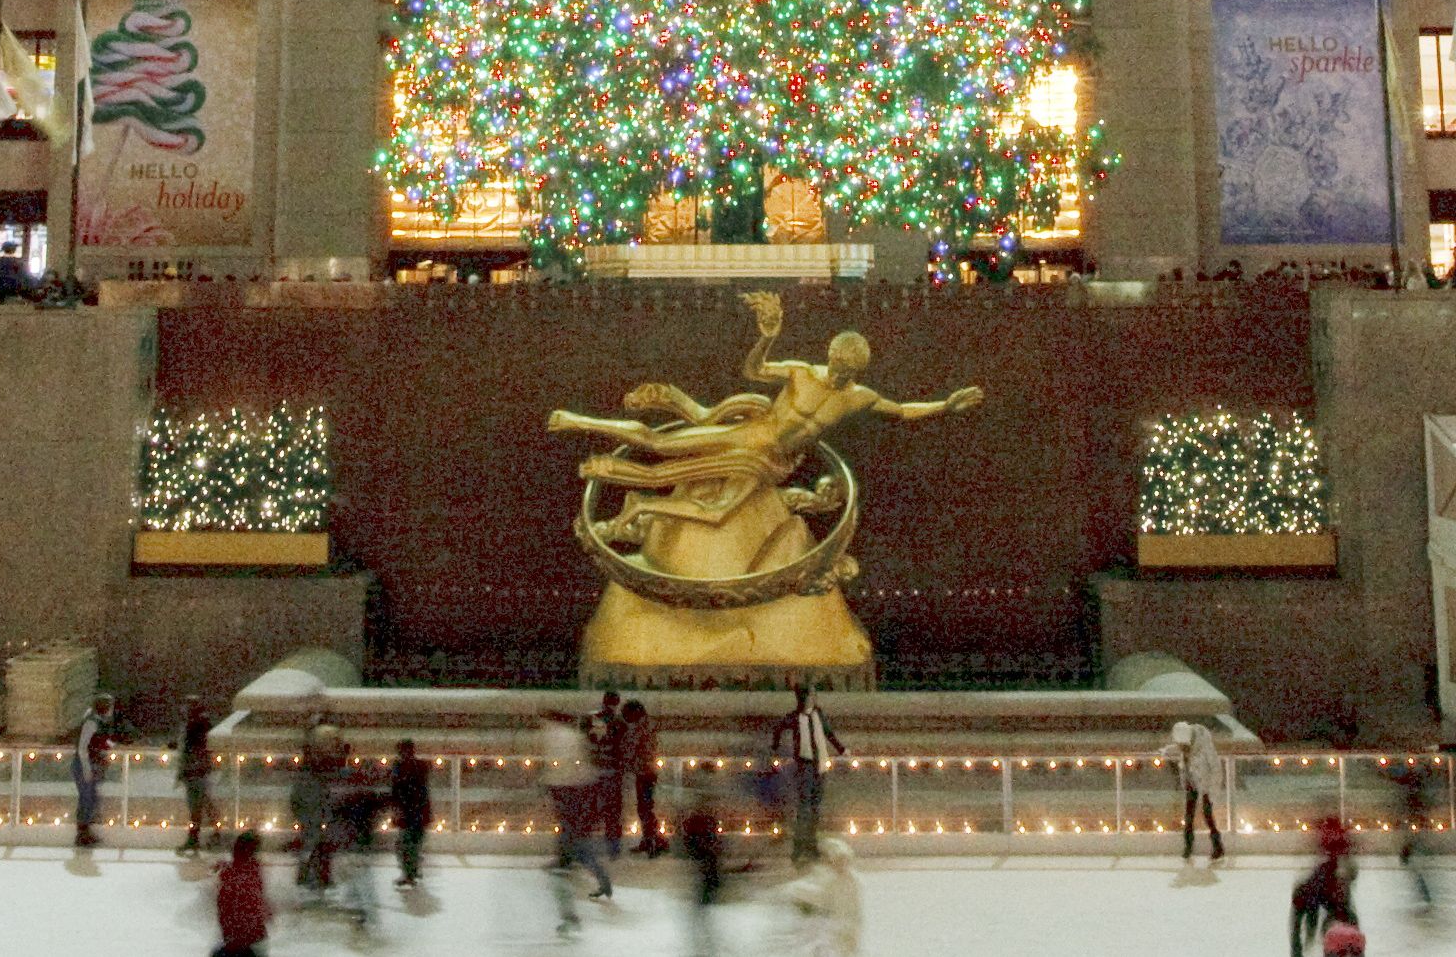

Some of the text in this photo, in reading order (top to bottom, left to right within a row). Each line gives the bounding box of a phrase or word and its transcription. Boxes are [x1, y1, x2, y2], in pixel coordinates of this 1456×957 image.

[1269, 36, 1338, 52] HELLO
[1289, 45, 1374, 82] sparkle
[130, 163, 199, 179] HELLO
[157, 180, 245, 221] holiday
